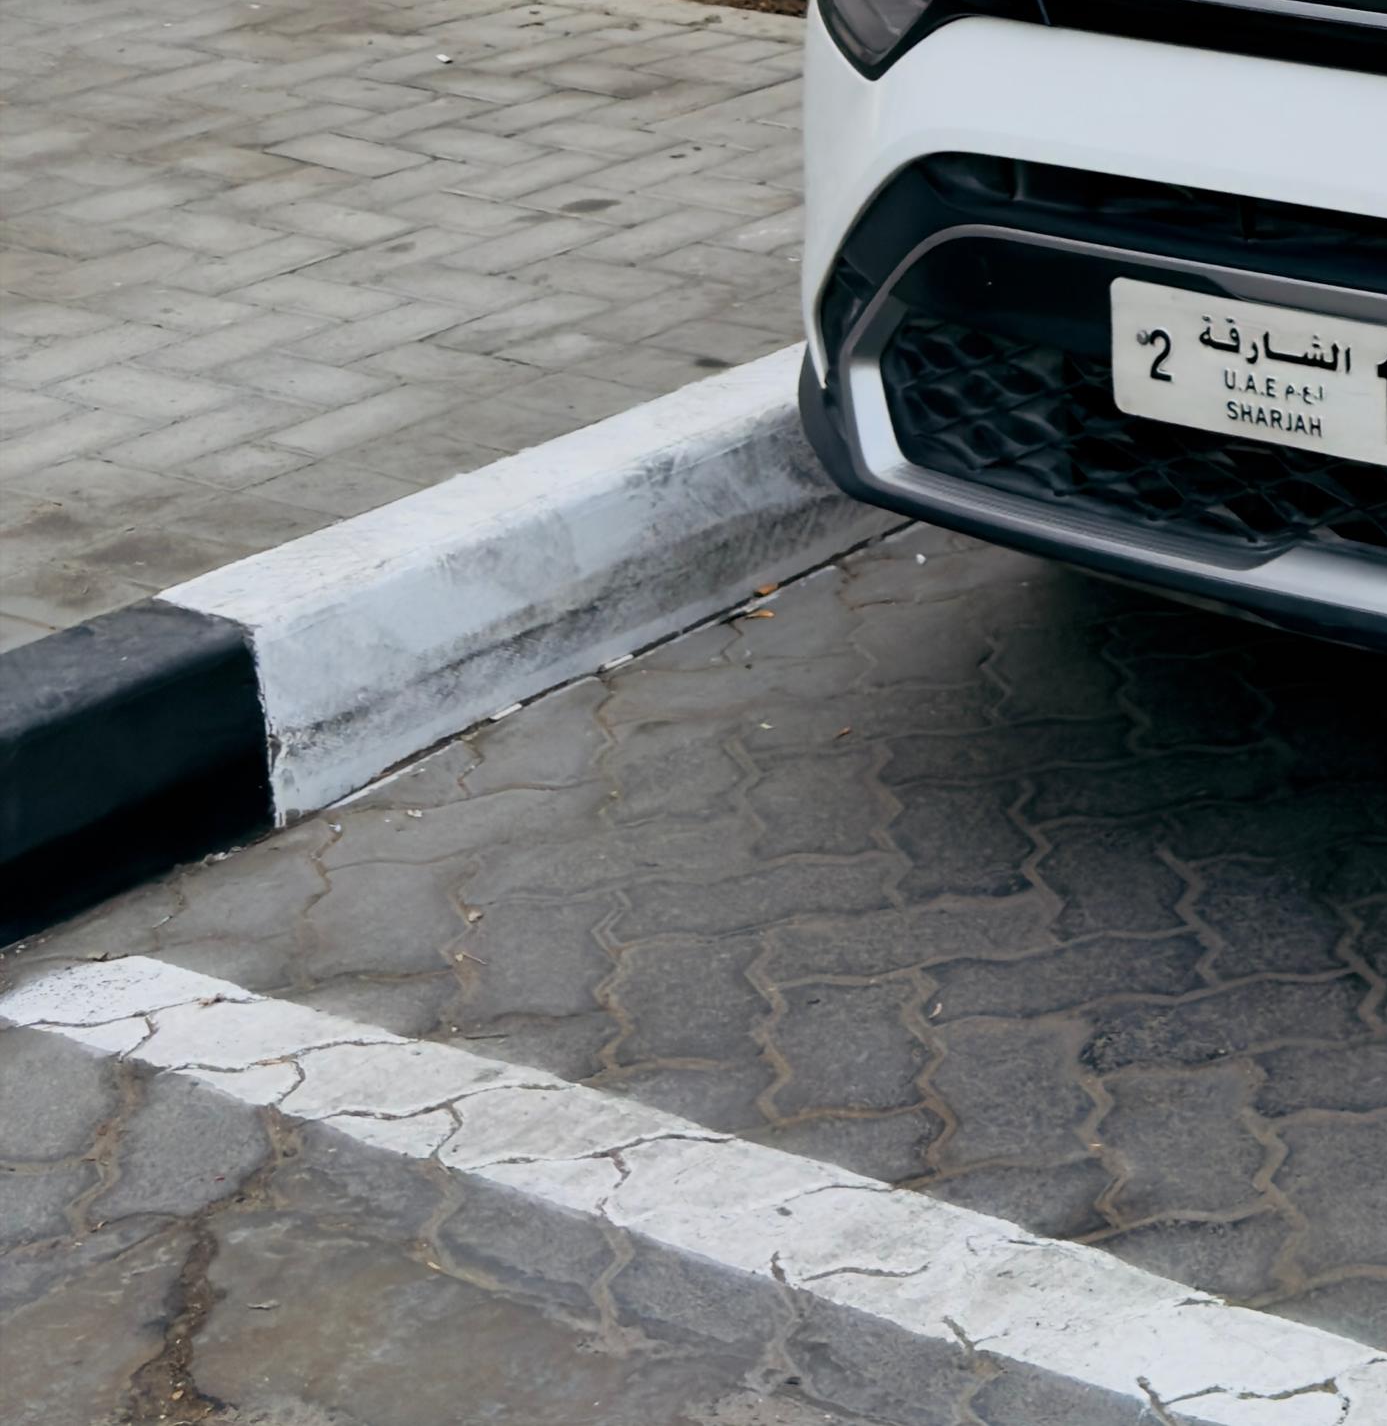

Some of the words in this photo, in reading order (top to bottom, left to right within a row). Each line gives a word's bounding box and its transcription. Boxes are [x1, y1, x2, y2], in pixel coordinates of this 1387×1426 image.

[1149, 327, 1174, 383] 2
[1199, 314, 1352, 375] الشارقة
[1223, 368, 1277, 400] U.A.E
[1226, 400, 1323, 440] SHARJAH
